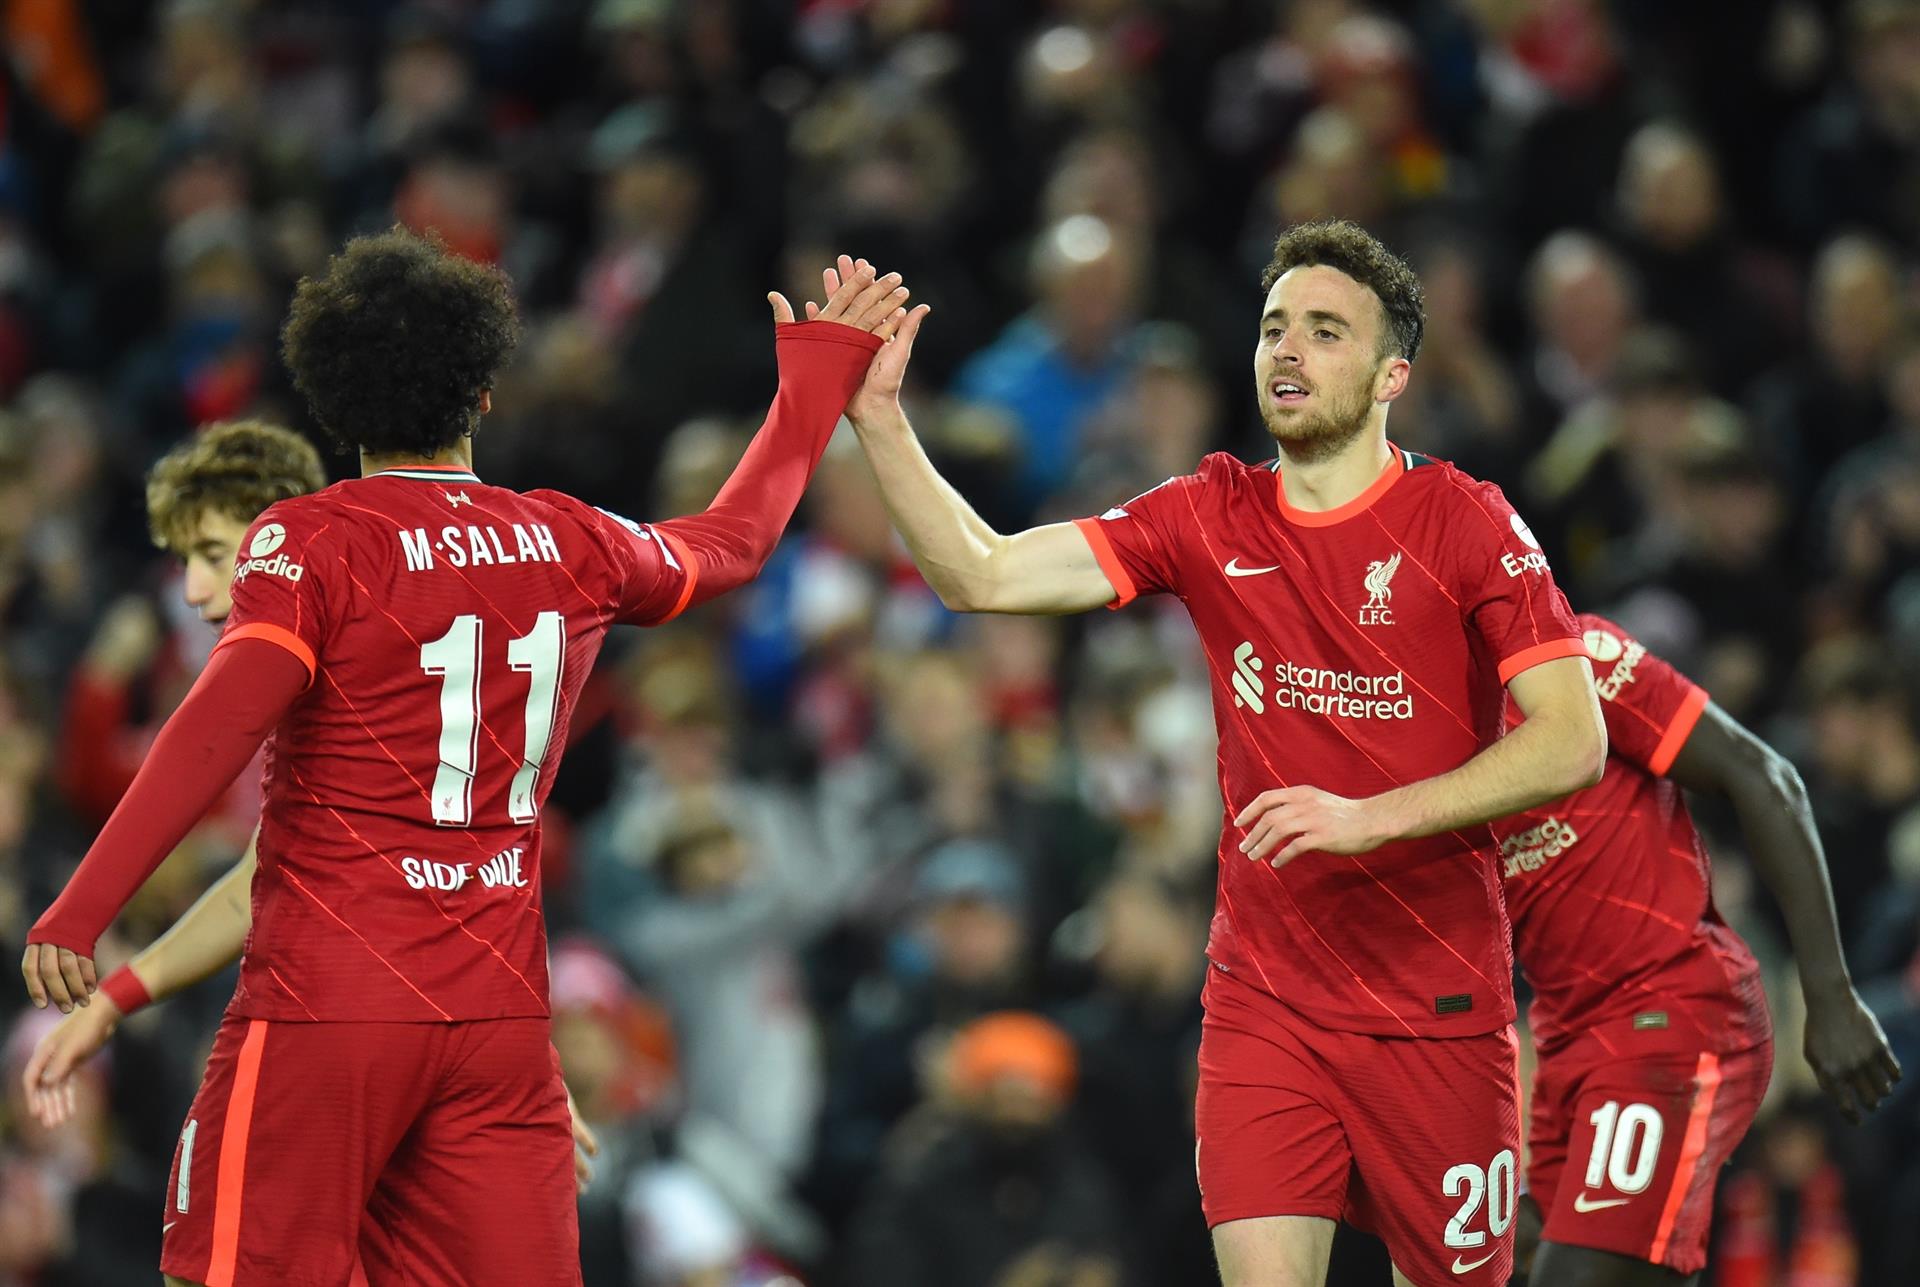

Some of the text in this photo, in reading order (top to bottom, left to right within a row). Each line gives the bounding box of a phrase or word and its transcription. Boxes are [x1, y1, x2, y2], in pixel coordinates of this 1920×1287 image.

[420, 611, 566, 827] 11
[1275, 661, 1403, 696] standard
[1275, 686, 1413, 719] chartered
[1585, 1100, 1664, 1194] 10
[1442, 1149, 1515, 1249] 20
